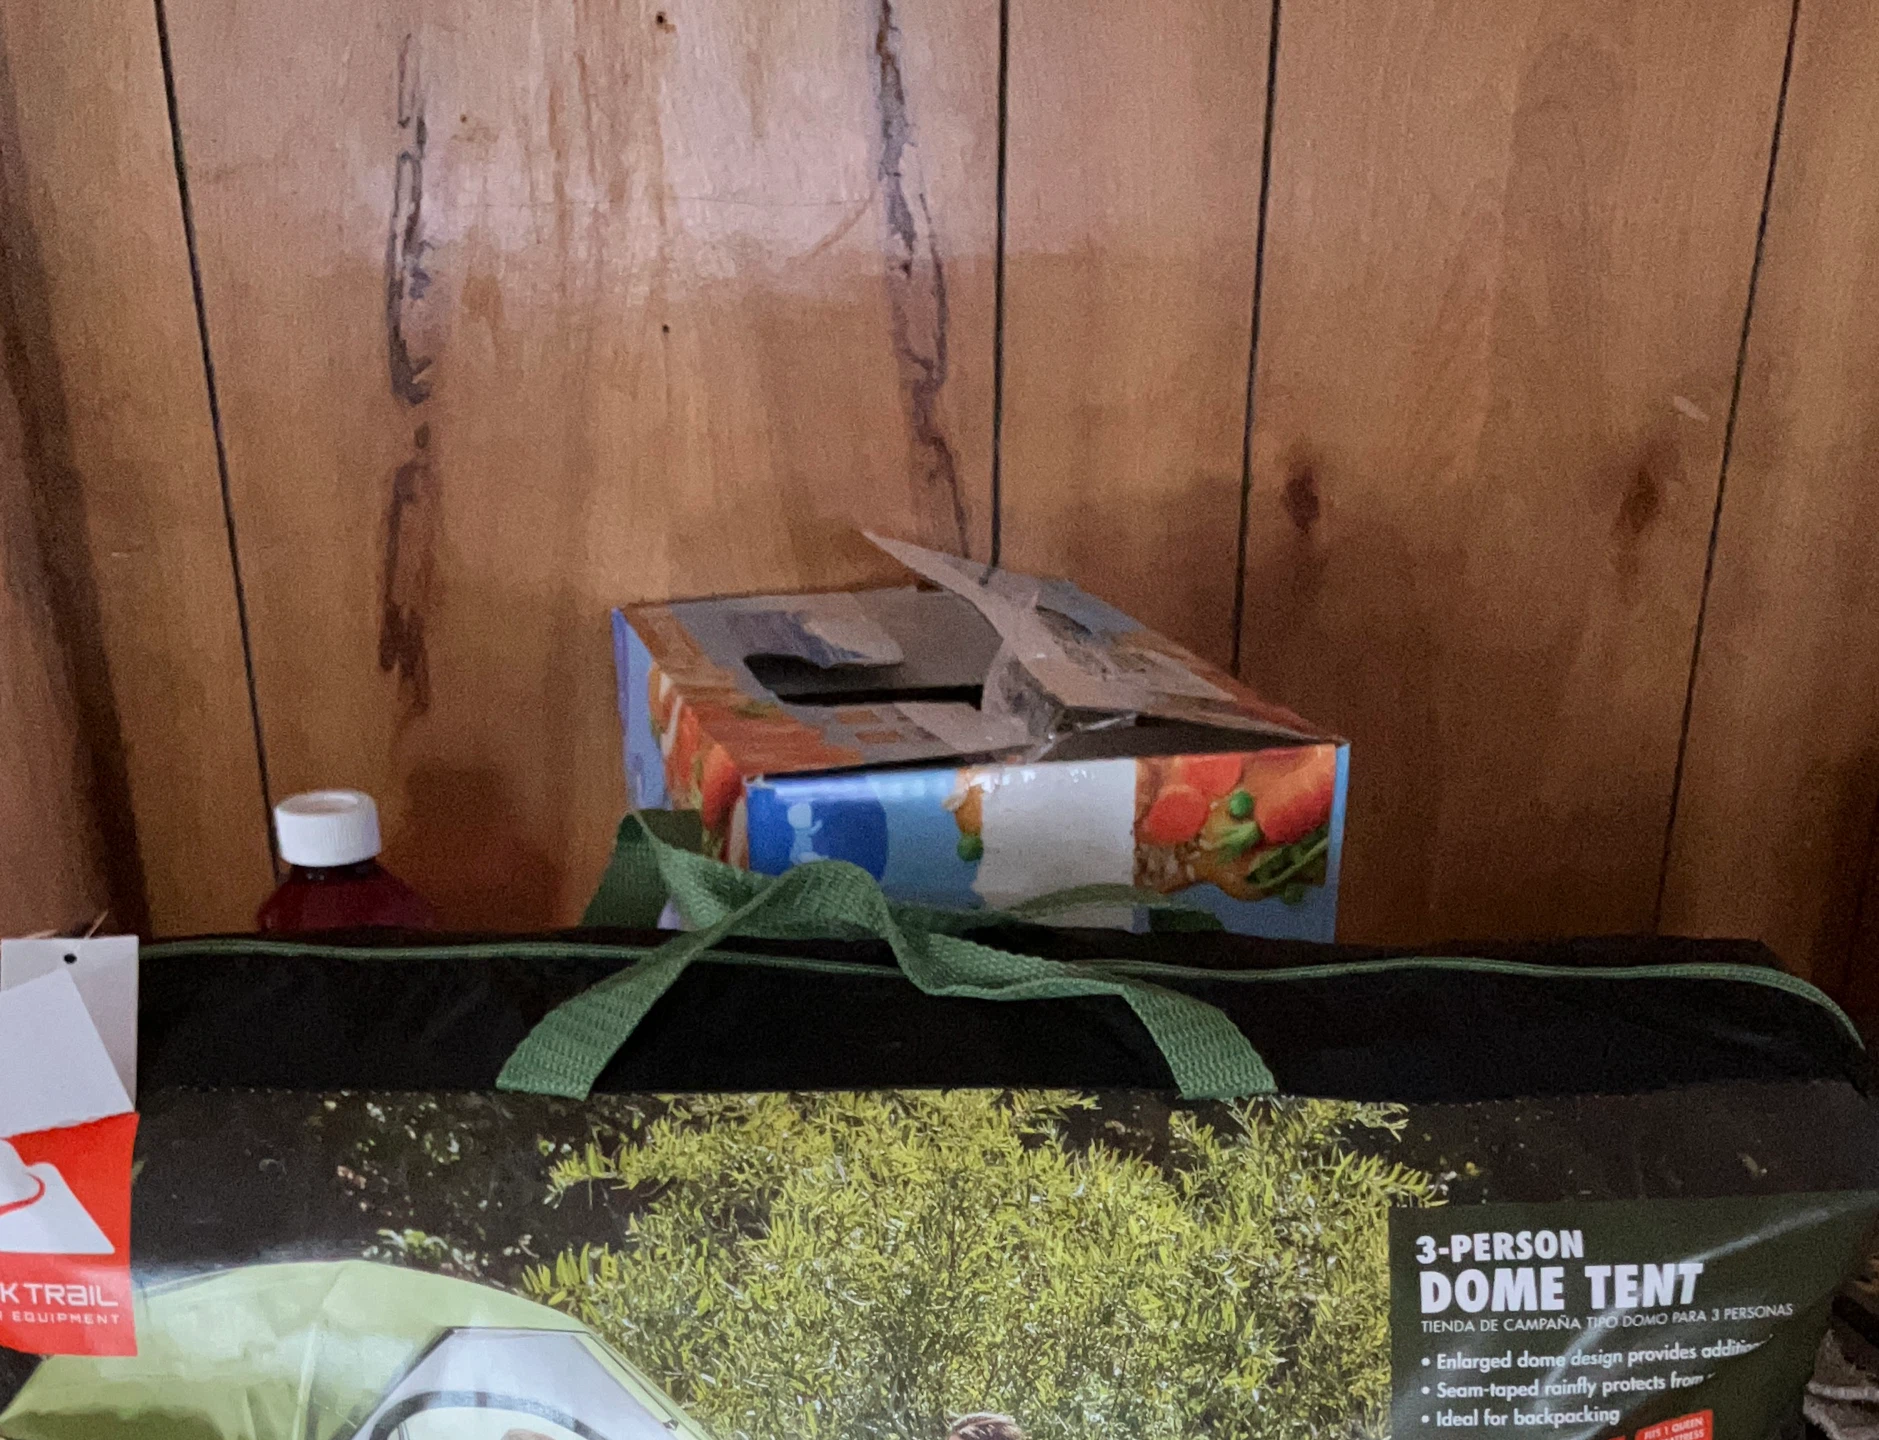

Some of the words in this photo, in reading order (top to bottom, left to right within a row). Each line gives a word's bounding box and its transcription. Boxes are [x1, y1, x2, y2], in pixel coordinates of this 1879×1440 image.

[1416, 1229, 1584, 1264] 3-PERSON
[1420, 1266, 1565, 1314] DOME
[1584, 1262, 1704, 1310] TENT
[11, 1310, 120, 1325] EQUIPMENT
[1421, 1319, 1475, 1333] TIENDA
[1480, 1318, 1499, 1332] DE
[1503, 1314, 1582, 1331] CAMPAÑA
[1586, 1315, 1618, 1330] TIPO
[1622, 1312, 1669, 1328] DOMO
[1672, 1309, 1707, 1324] PARA
[1711, 1308, 1720, 1322] 3
[1724, 1302, 1794, 1321] PERSONAS
[1436, 1350, 1512, 1373] Enlarged
[1517, 1350, 1566, 1369] dome
[1570, 1348, 1623, 1369] design
[1627, 1341, 1696, 1367] provides
[1436, 1378, 1540, 1402] Seam-taped
[1544, 1376, 1597, 1398] rainfly
[1602, 1375, 1666, 1397] protects
[1670, 1370, 1705, 1389] from
[1436, 1408, 1479, 1427] Ideal
[1483, 1408, 1508, 1426] for
[1514, 1405, 1620, 1429] backpacking
[1671, 1416, 1704, 1434] QUEEN
